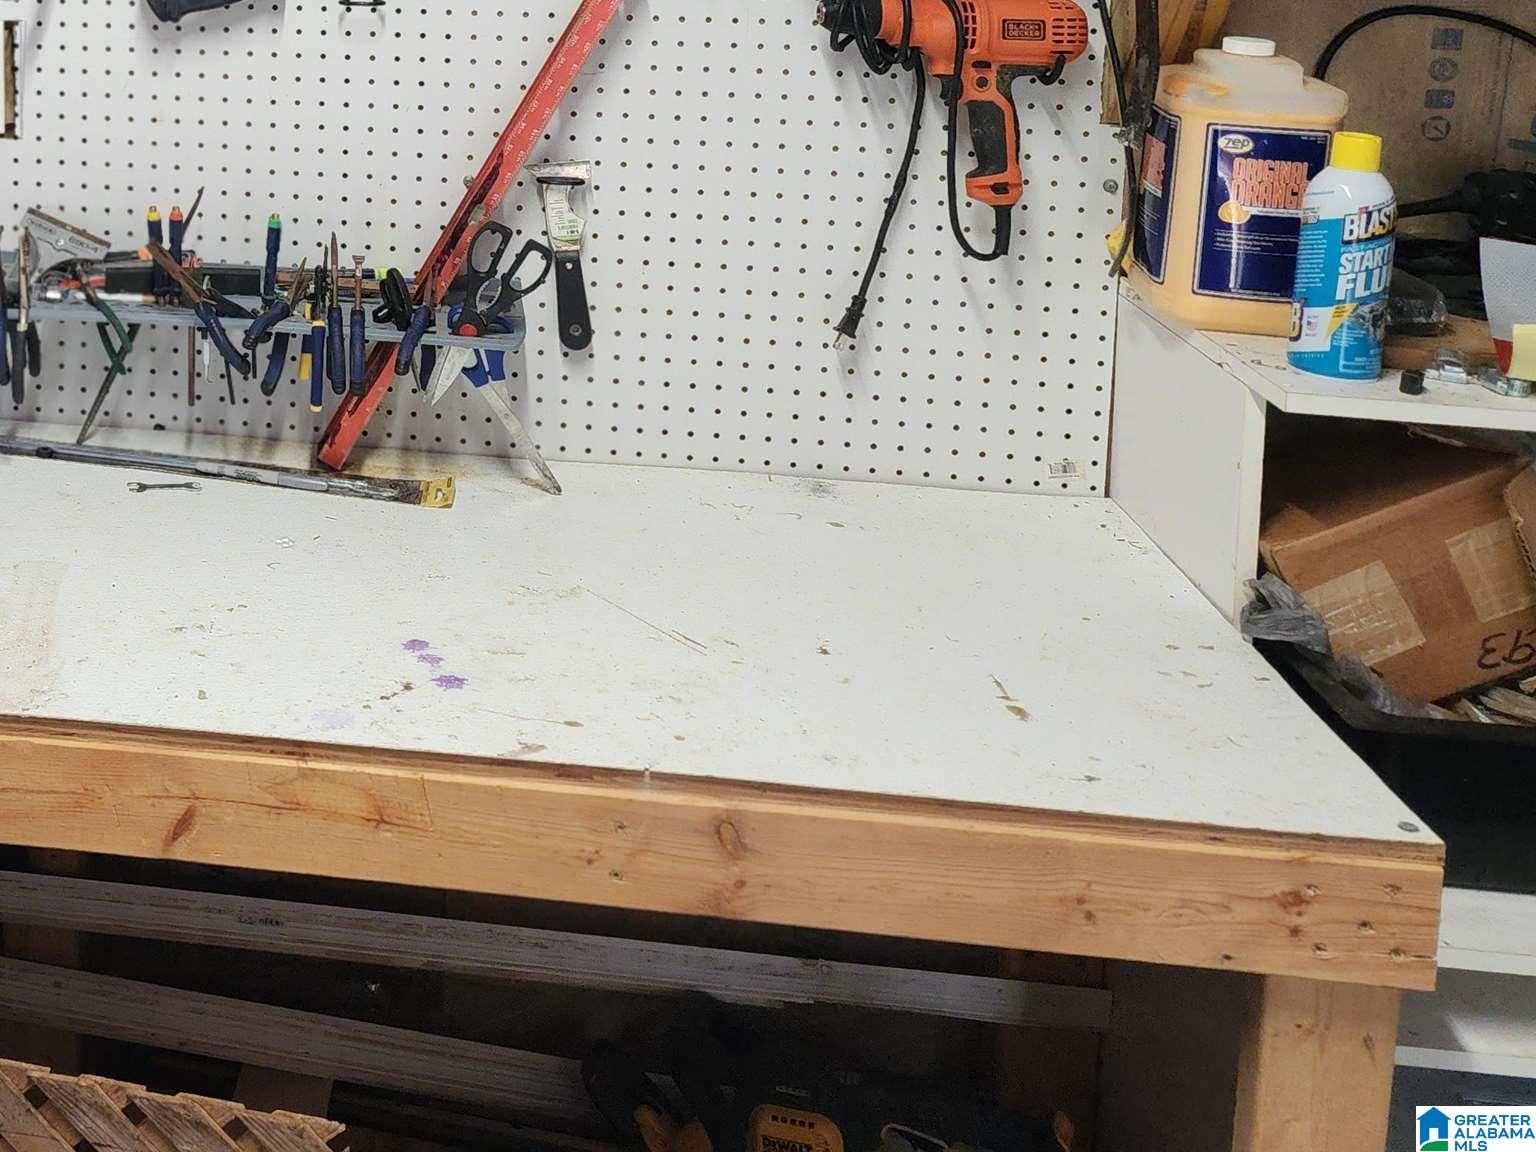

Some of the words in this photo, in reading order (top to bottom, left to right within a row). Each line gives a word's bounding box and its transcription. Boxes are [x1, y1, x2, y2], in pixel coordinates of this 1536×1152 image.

[1232, 157, 1309, 183] ORIGINAL
[1344, 206, 1396, 242] BLAST
[1338, 244, 1394, 275] START
